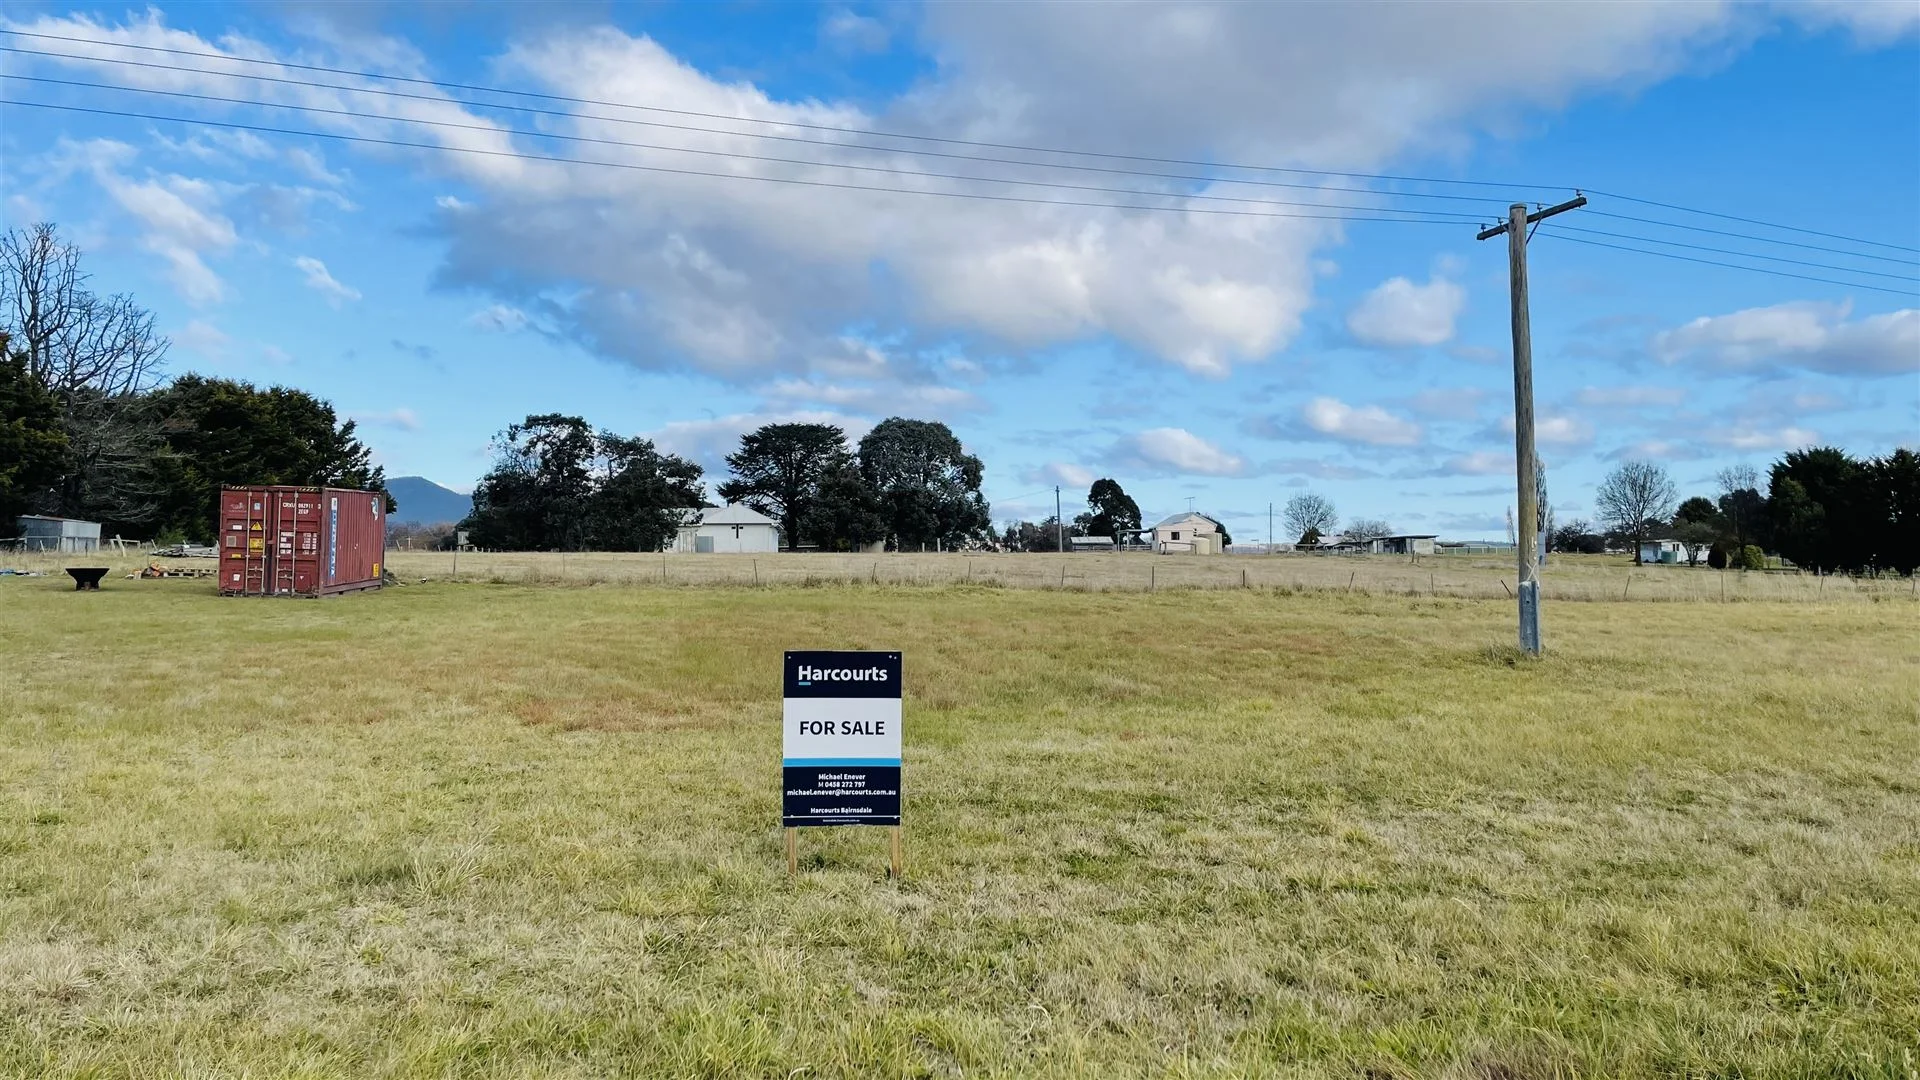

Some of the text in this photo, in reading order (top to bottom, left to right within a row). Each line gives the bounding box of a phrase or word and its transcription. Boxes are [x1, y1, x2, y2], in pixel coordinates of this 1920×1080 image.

[798, 665, 888, 681] Harcourts
[799, 720, 885, 736] FOR SALE
[786, 788, 897, 796] michael.enever@harcourts.com.au
